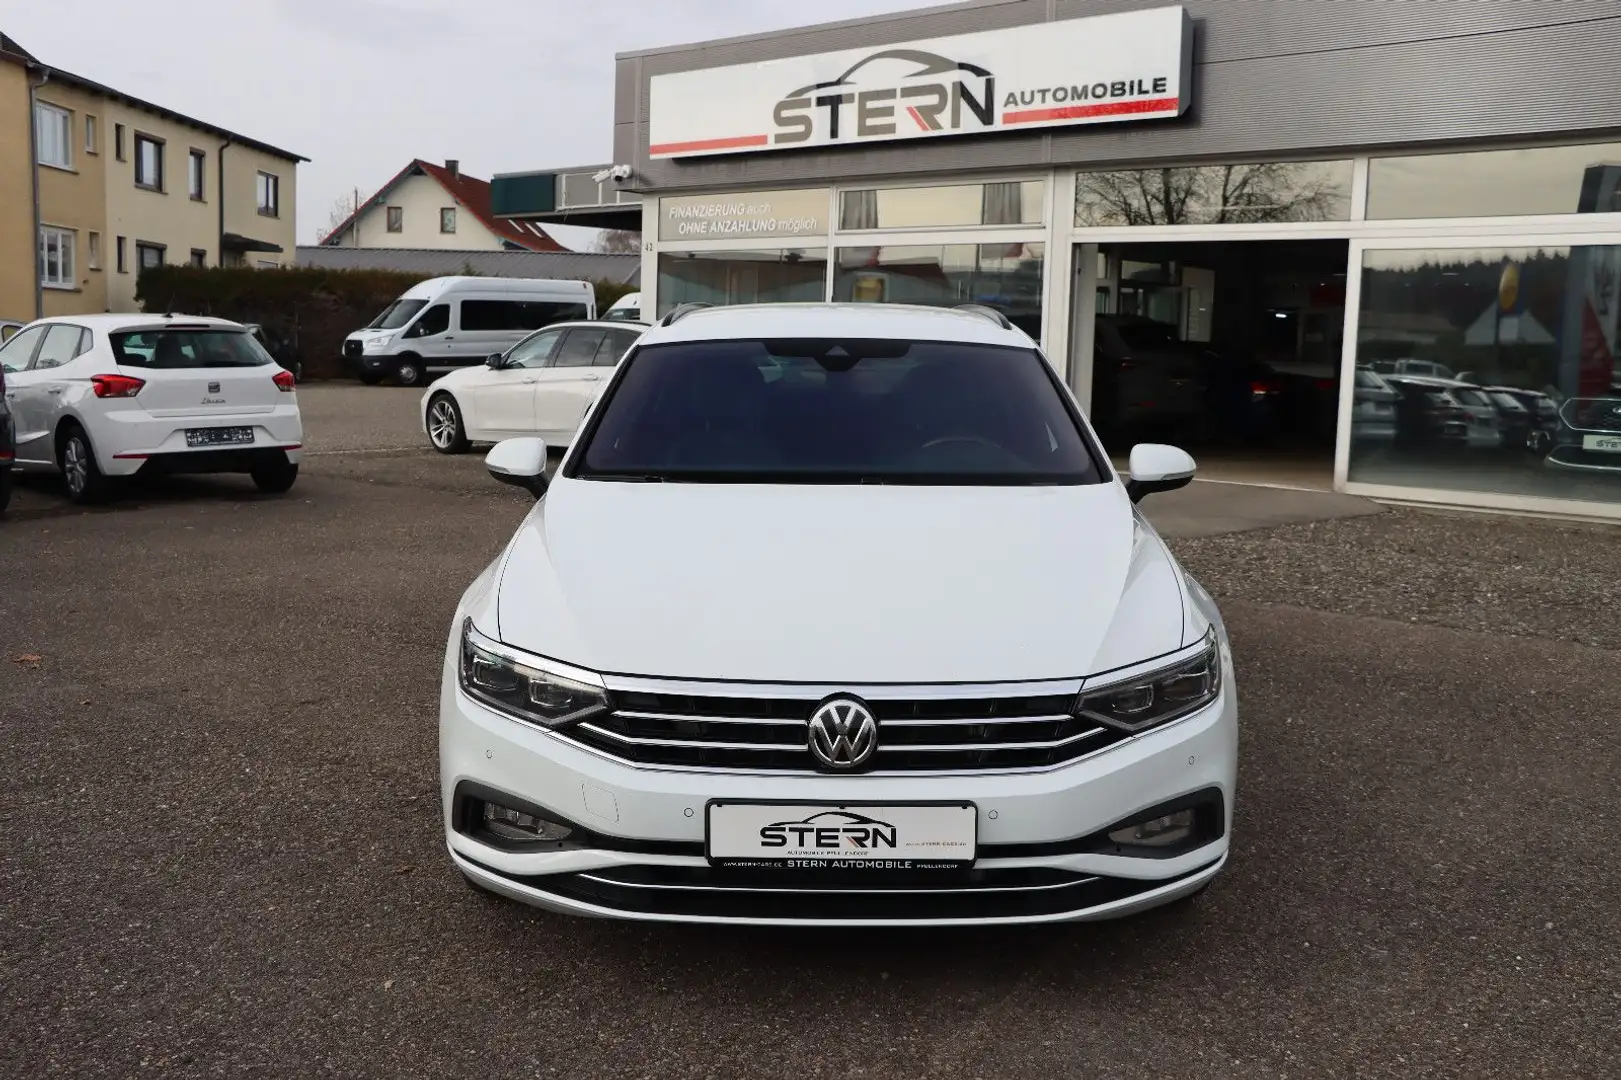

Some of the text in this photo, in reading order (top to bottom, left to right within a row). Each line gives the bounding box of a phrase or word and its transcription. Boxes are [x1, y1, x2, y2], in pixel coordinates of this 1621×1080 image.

[773, 76, 1168, 145] STERN AUTOMOBILE
[669, 203, 772, 219] FINANZIERUNG auch
[679, 216, 817, 234] OHNE ANZAHLUNG möglich
[760, 827, 897, 848] STERN
[787, 860, 827, 868] STERN
[832, 861, 912, 869] AUTOMOBILE
